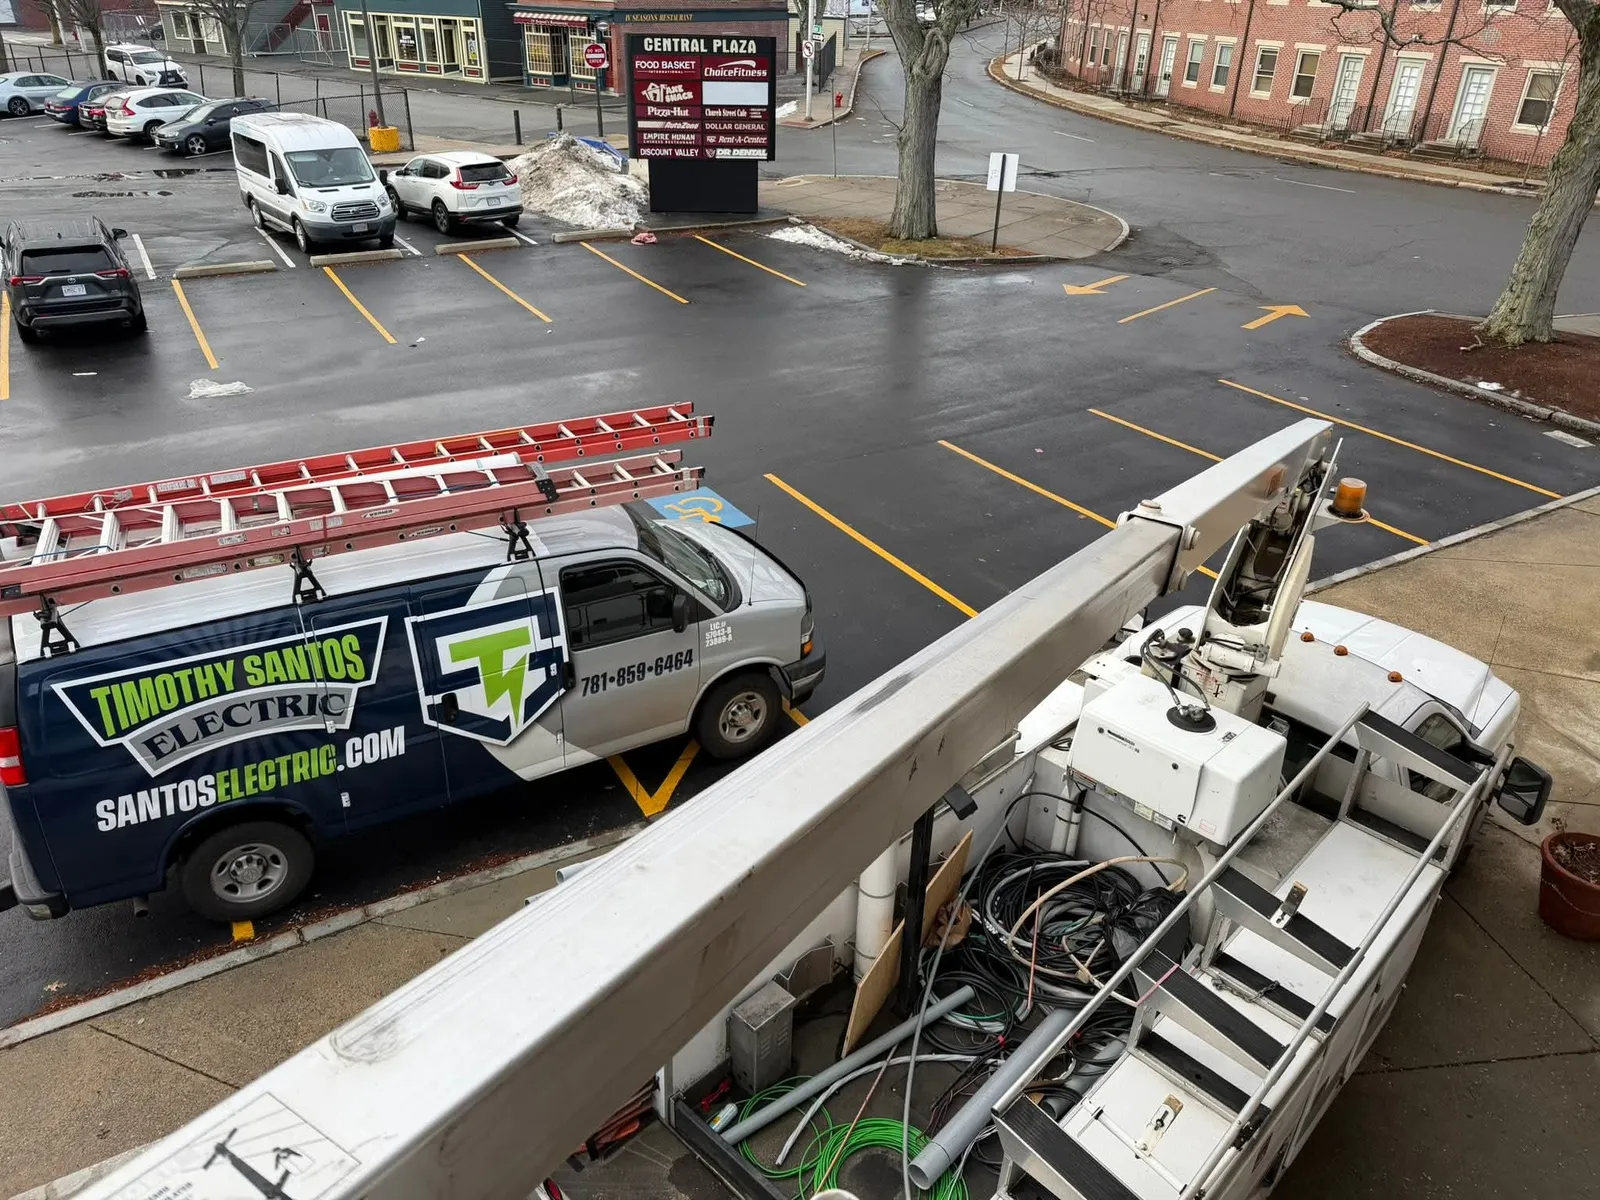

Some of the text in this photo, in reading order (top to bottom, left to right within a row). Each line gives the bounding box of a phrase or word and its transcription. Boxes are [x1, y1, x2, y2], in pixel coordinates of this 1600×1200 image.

[643, 37, 757, 54] CENTRAL PLAZA
[635, 60, 696, 69] FOOD BASKET
[704, 67, 768, 77] ChoiceFitness
[665, 91, 694, 103] SHACK
[705, 108, 721, 117] Church
[722, 109, 737, 117] Street
[665, 121, 699, 129] AutoZone
[671, 133, 696, 141] HUNAN
[640, 148, 699, 157] DISCOUNT VALLEY
[715, 148, 768, 157] DR DENTAL
[90, 634, 366, 738] TIMOTHY SANTOS
[140, 693, 347, 762] ELECTRIC
[95, 725, 406, 832] SANTOSELECTRIC.COM
